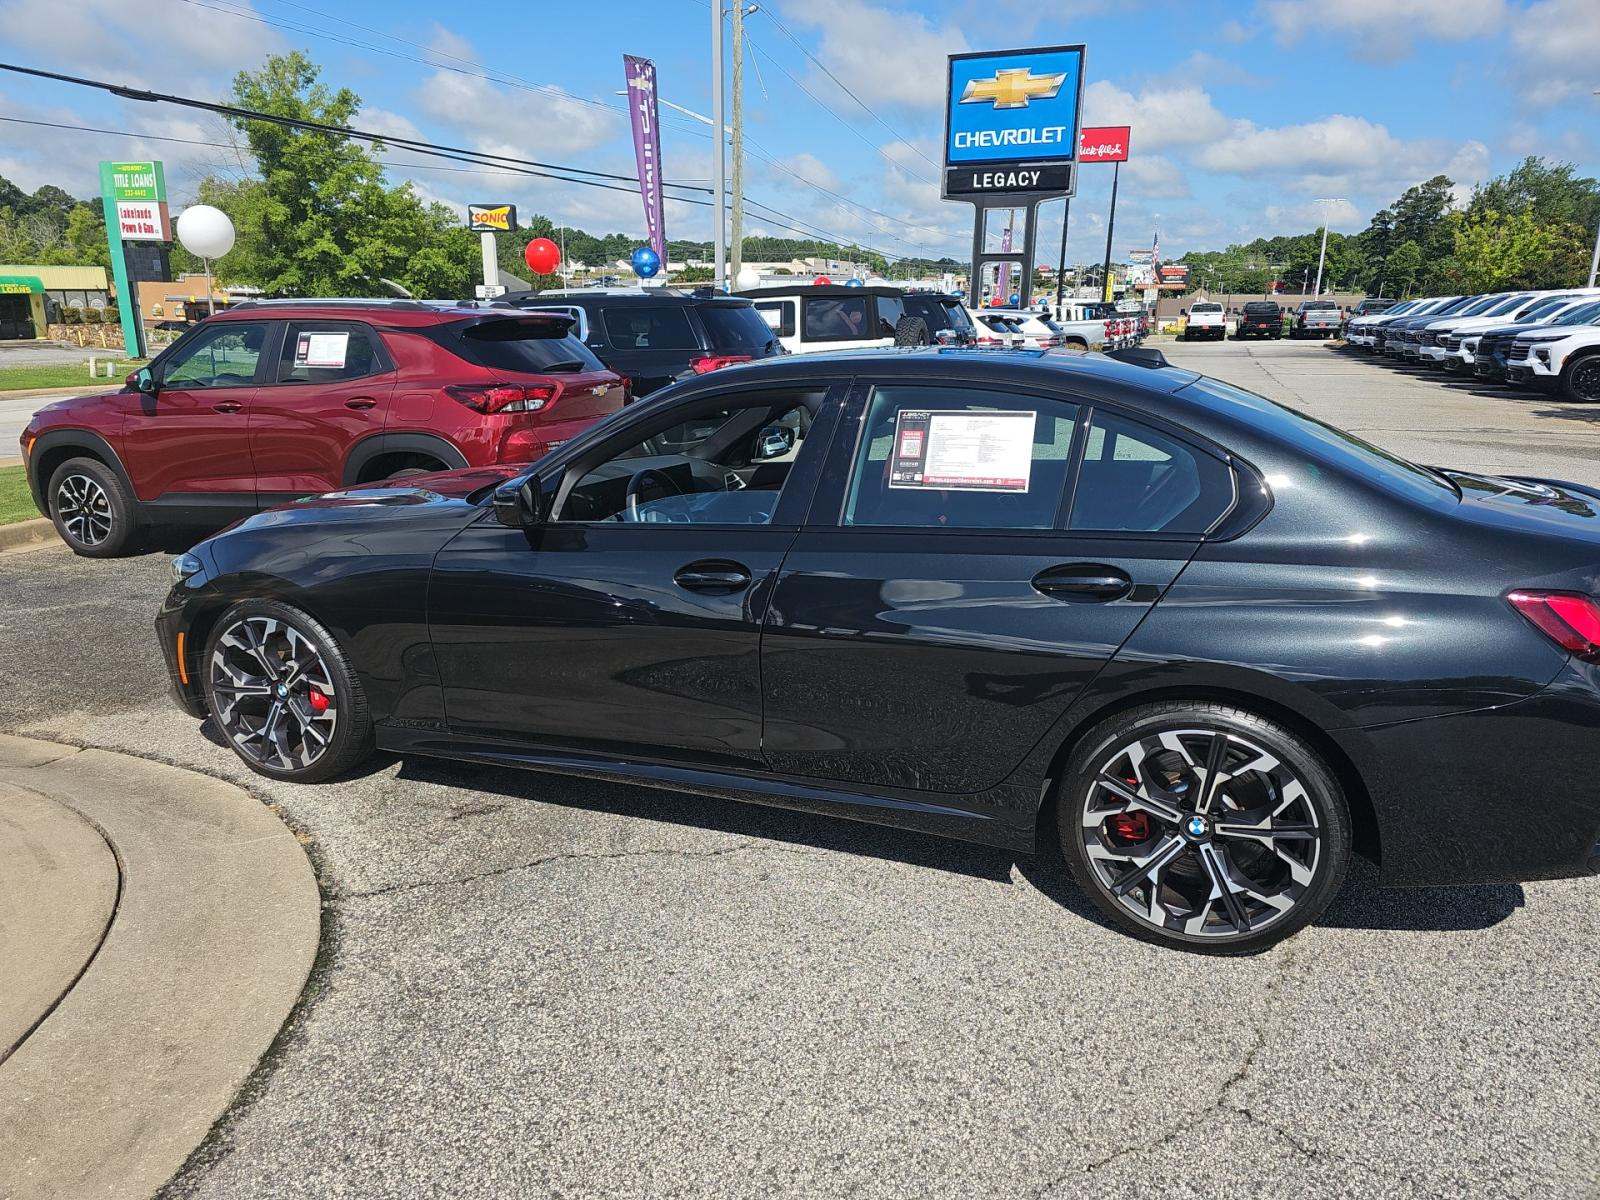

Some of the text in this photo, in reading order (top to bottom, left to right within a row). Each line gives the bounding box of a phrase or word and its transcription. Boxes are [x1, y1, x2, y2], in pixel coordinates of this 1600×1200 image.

[955, 126, 1066, 148] CHEVROLET
[113, 174, 153, 188] TITLE LOANS
[973, 171, 1041, 188] LEGACY
[120, 208, 152, 220] Lakelands
[474, 213, 507, 223] SONIC
[122, 222, 137, 234] Pawn
[143, 223, 155, 234] Gun
[2, 286, 32, 294] LOANS
